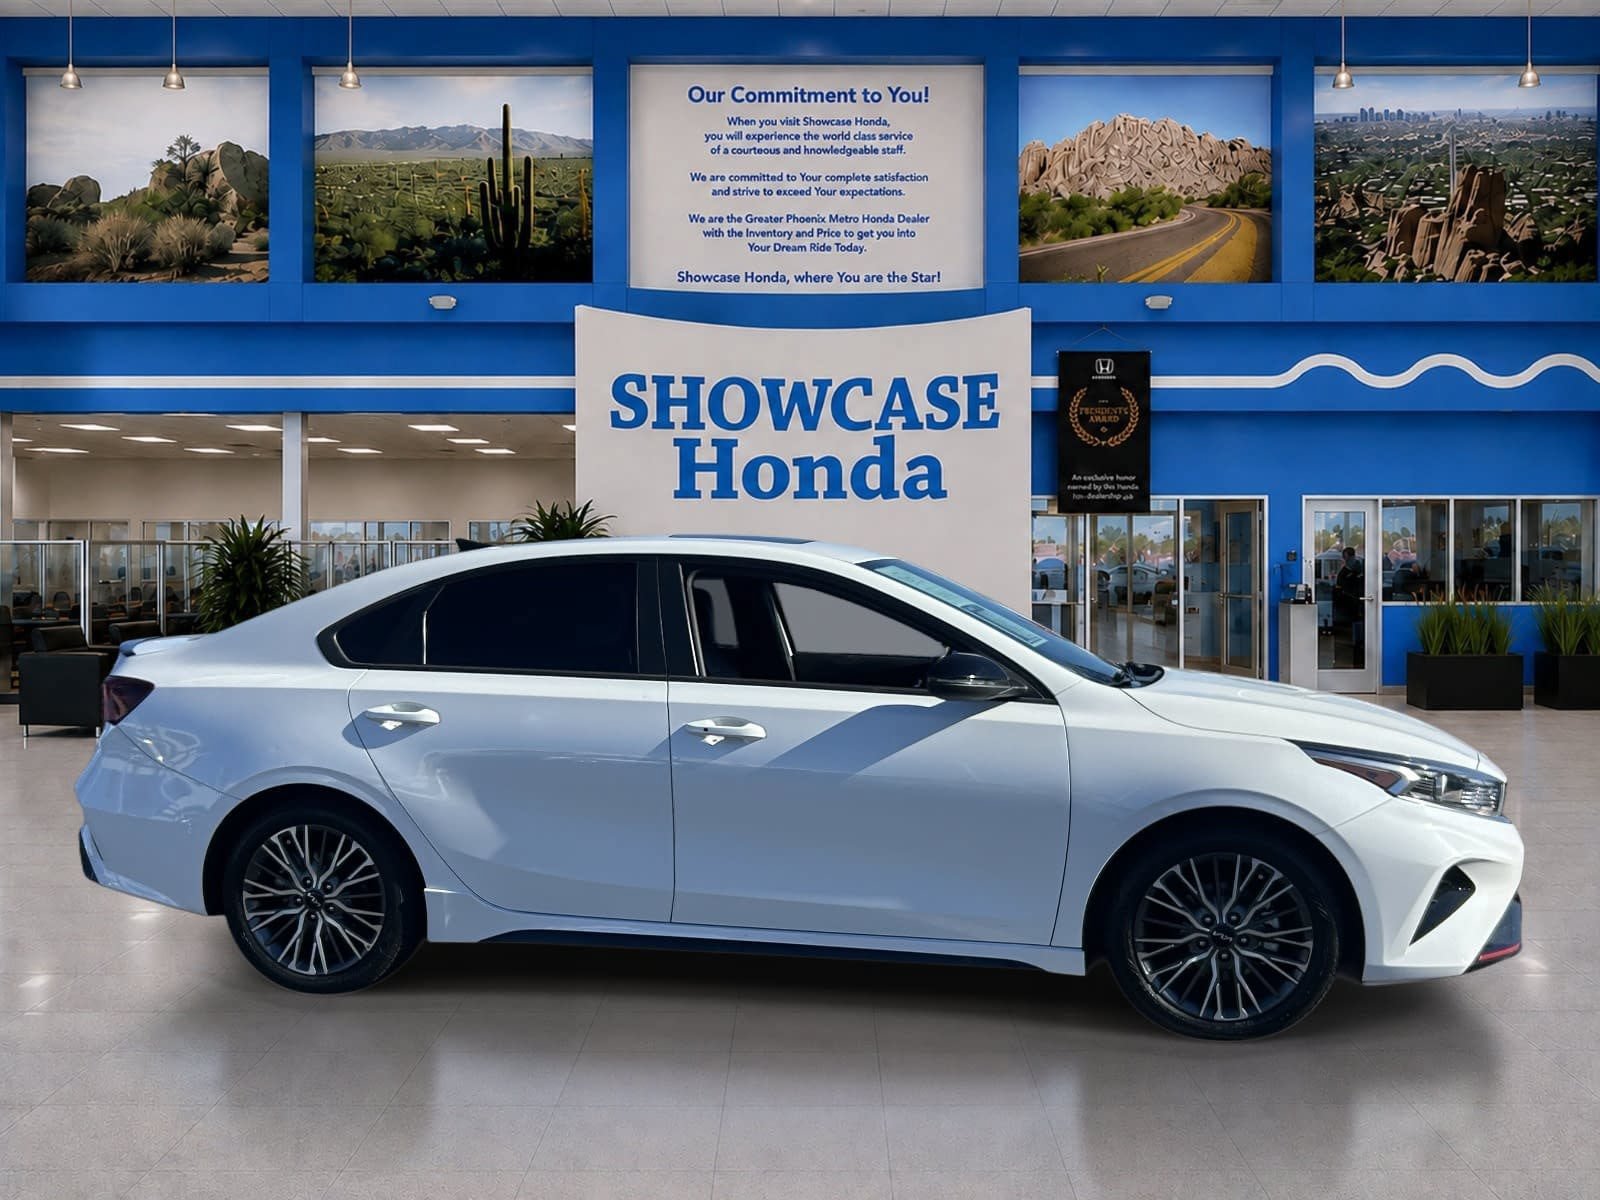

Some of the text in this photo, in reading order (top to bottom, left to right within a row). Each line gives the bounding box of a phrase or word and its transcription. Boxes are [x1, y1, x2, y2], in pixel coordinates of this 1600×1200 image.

[688, 86, 928, 103] Our Commitment to You!
[727, 116, 890, 128] When you visit Showcase Honda,
[705, 131, 913, 143] you will experience the world class service
[710, 144, 721, 154] of
[731, 147, 780, 155] courteous
[783, 145, 801, 154] and
[882, 144, 906, 154] staff.
[690, 172, 707, 182] We
[728, 172, 783, 182] committed
[786, 174, 797, 182] to
[800, 172, 822, 182] Your
[825, 172, 871, 184] complete
[874, 172, 928, 182] satisfaction
[712, 186, 905, 199] and strive to exceed Your expectations.
[688, 214, 930, 224] We are the Greater Phoenix Metro Honda Dealer
[702, 228, 916, 240] with the Inventory and Price to get you into
[748, 242, 866, 254] Your Dream Ride Today.
[678, 271, 940, 285] Showcase Honda, where You are the Star!
[610, 373, 1000, 431] SHOWCASE
[673, 434, 948, 500] Honda
